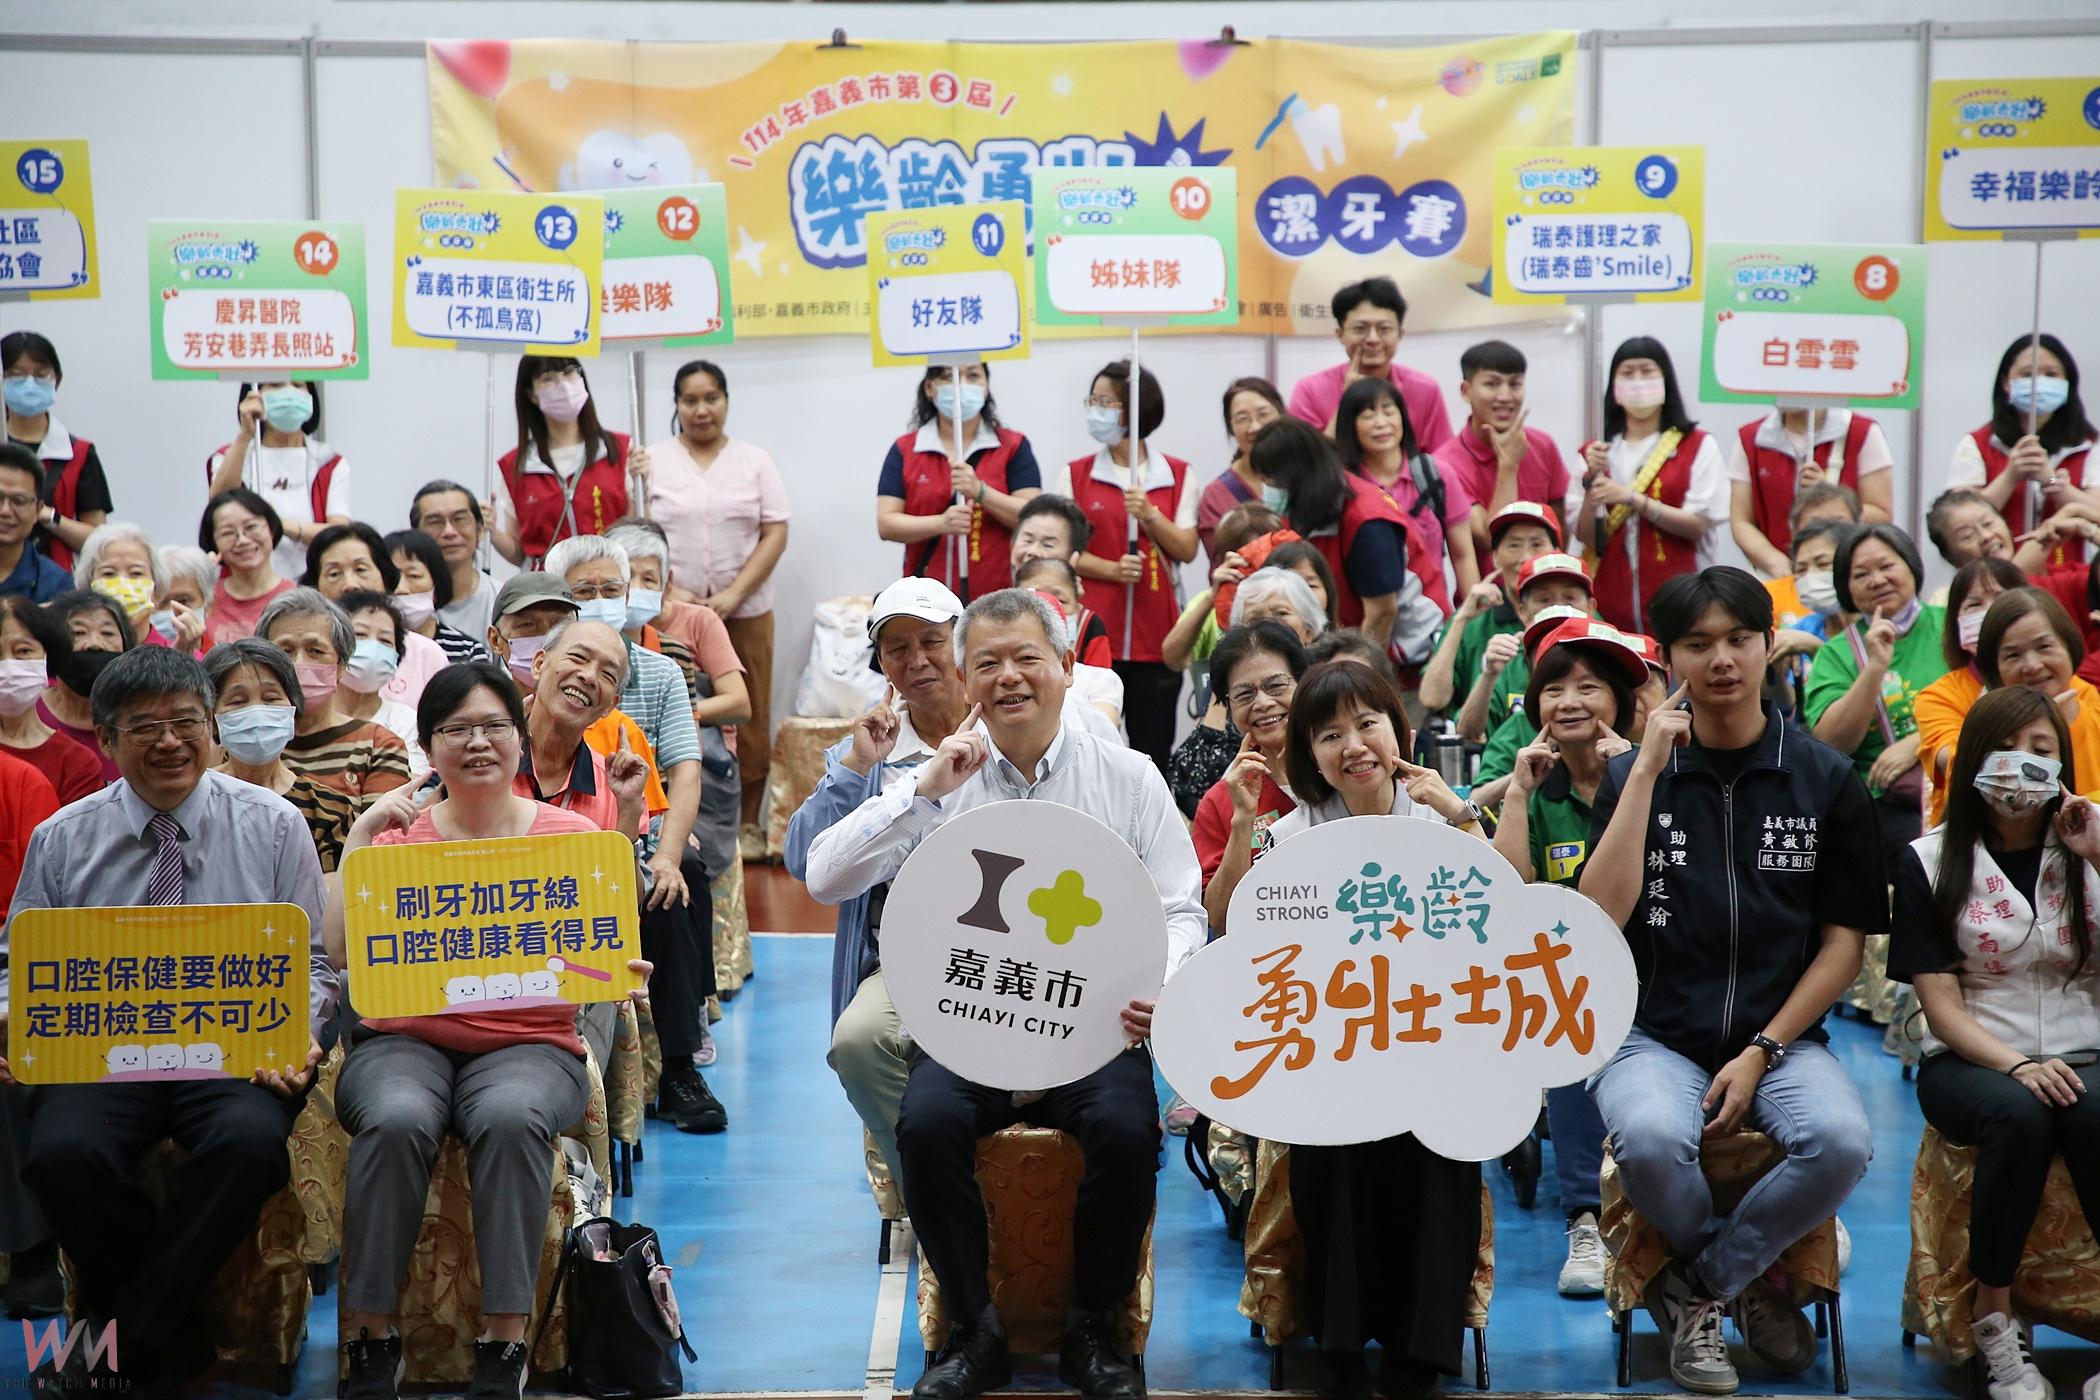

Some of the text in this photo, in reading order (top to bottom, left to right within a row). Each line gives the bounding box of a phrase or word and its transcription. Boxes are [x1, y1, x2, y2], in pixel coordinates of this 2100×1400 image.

[25, 159, 57, 184] 15
[1644, 164, 1666, 191] 9
[1970, 169, 2100, 202] 幸福樂齡
[1174, 184, 1207, 211] 10
[541, 214, 572, 241] 13
[663, 206, 694, 232] 12
[1268, 192, 1457, 246] 潔牙賽
[977, 222, 1000, 248] 11
[1532, 223, 1662, 249] 瑞泰護理之家
[301, 239, 332, 267] 14
[415, 271, 576, 304] 嘉義市東區衛生所
[1091, 260, 1181, 290] 姊妹隊
[1864, 264, 1889, 291] 8
[216, 298, 301, 325] 慶昇醫院
[601, 281, 673, 313] 樂隊
[911, 295, 983, 327] 好友隊
[184, 332, 334, 358] 芳安巷弄長照站
[1762, 338, 1860, 370] 白雪雪
[1763, 815, 1817, 832] 嘉義市議員
[1670, 830, 1687, 866] 助理
[1761, 853, 1814, 869] 服務團隊
[396, 875, 580, 921] 刷牙加牙線
[1256, 885, 1318, 901] CHIAYI
[1647, 849, 1672, 927] 林廷翰
[1256, 905, 1329, 921] STRONG
[1336, 862, 1492, 945] 樂齡
[366, 916, 624, 966] 口腔健康看得見
[28, 953, 293, 993] 口腔保健要做好
[944, 947, 1088, 1009] 嘉義市
[26, 998, 291, 1038] 定期檢查不可少
[938, 998, 1075, 1040] CHIAYI CITY
